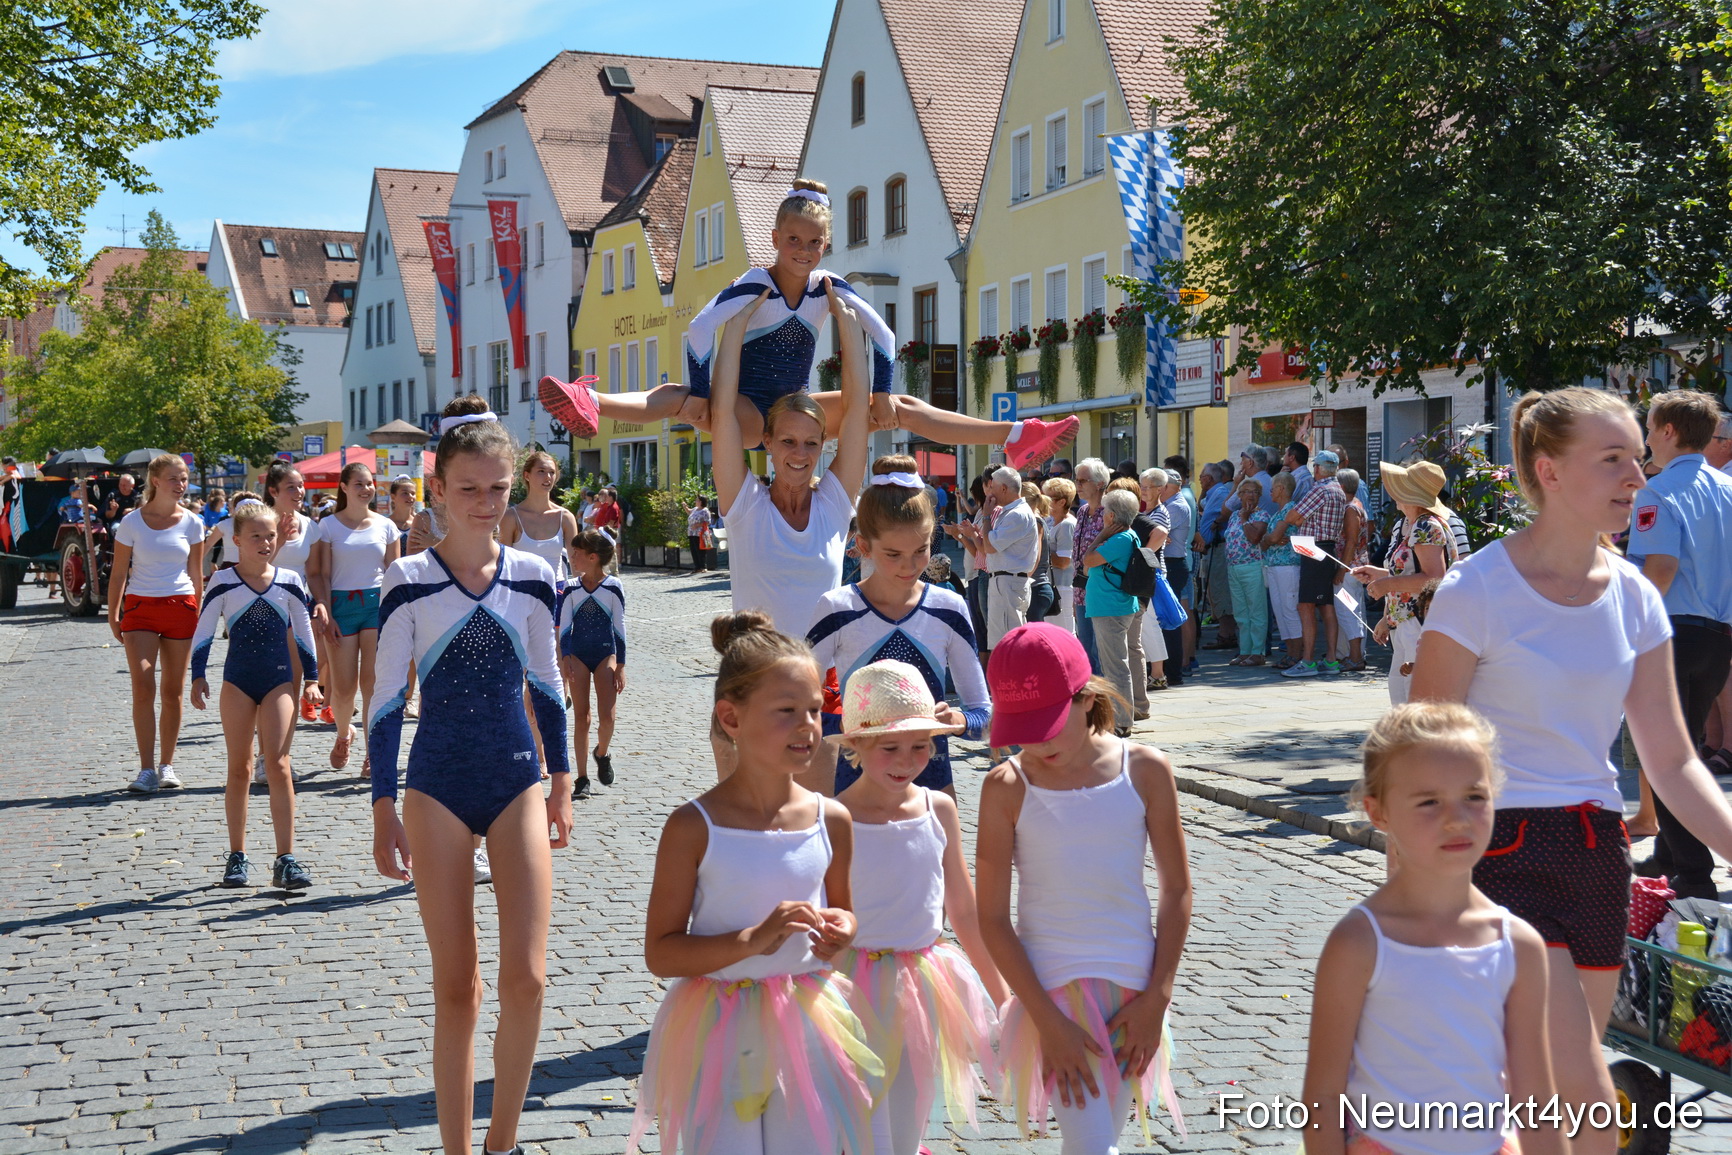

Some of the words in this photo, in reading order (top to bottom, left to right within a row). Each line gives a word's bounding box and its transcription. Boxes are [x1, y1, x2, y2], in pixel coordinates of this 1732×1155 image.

[614, 315, 637, 338] HOTEL
[642, 311, 668, 330] Lehmeier
[1187, 366, 1202, 380] KINO
[1214, 340, 1223, 401] KINO
[997, 396, 1012, 422] P
[997, 679, 1018, 690] Jack
[997, 690, 1041, 702] Wolfskin
